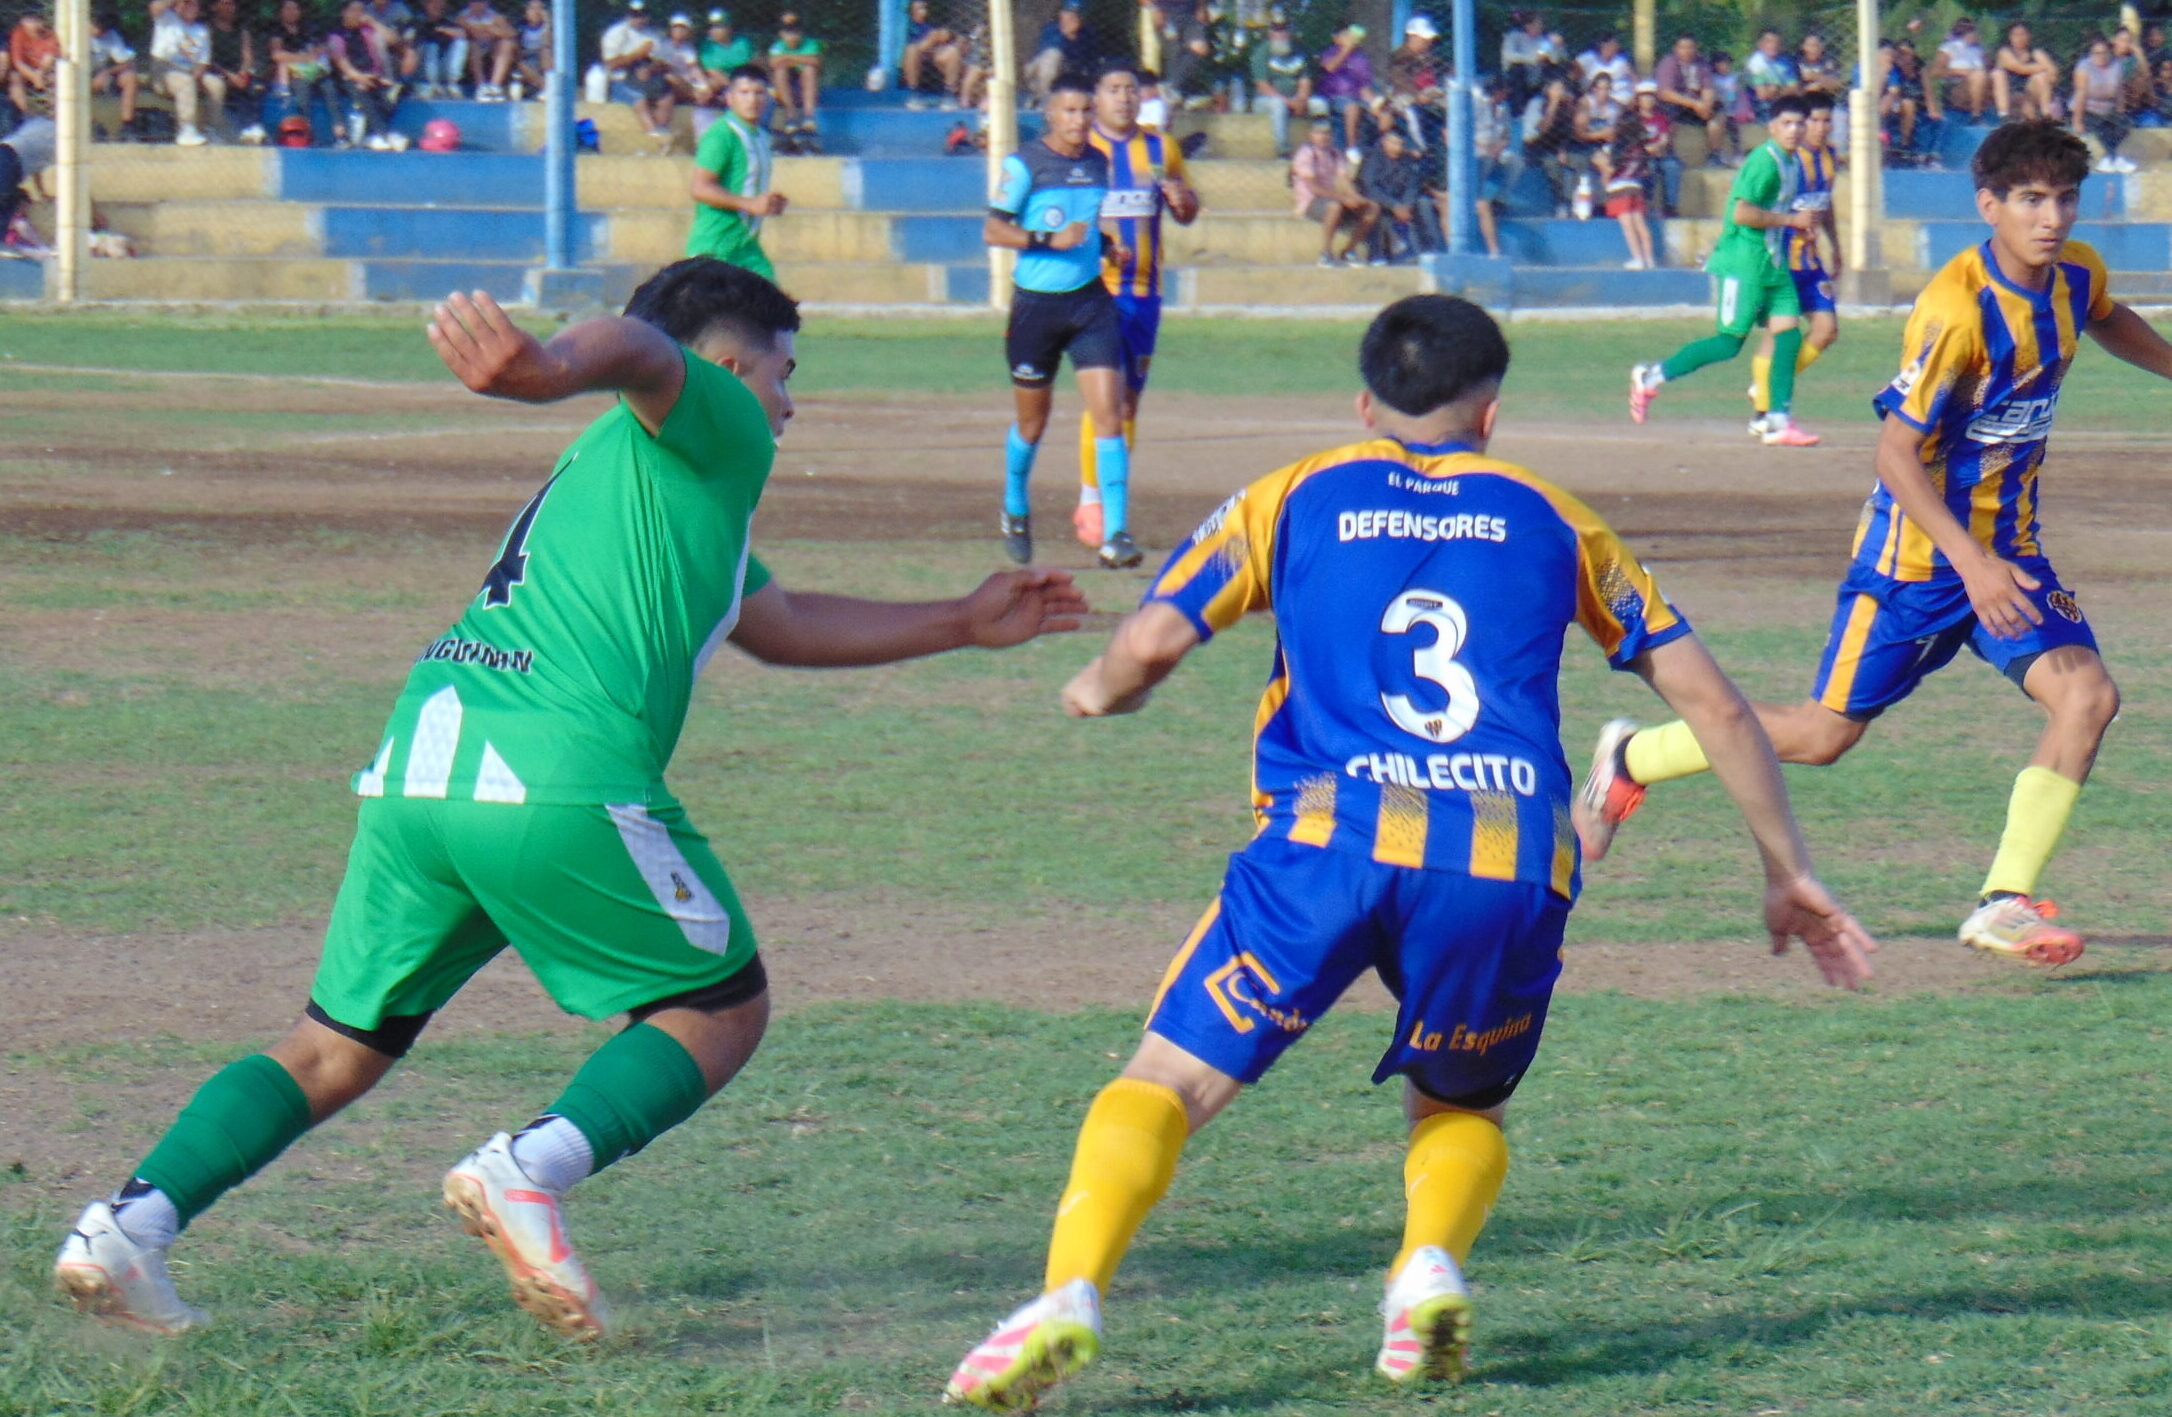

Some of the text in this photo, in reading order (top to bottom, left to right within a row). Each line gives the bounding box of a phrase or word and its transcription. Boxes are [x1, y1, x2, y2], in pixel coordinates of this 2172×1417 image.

[1388, 472, 1402, 488] EL
[1339, 509, 1506, 542] DEFENSORES
[1381, 588, 1480, 744] 3
[1346, 752, 1535, 796] CHILECITO
[1409, 1012, 1533, 1056] La Esquina
